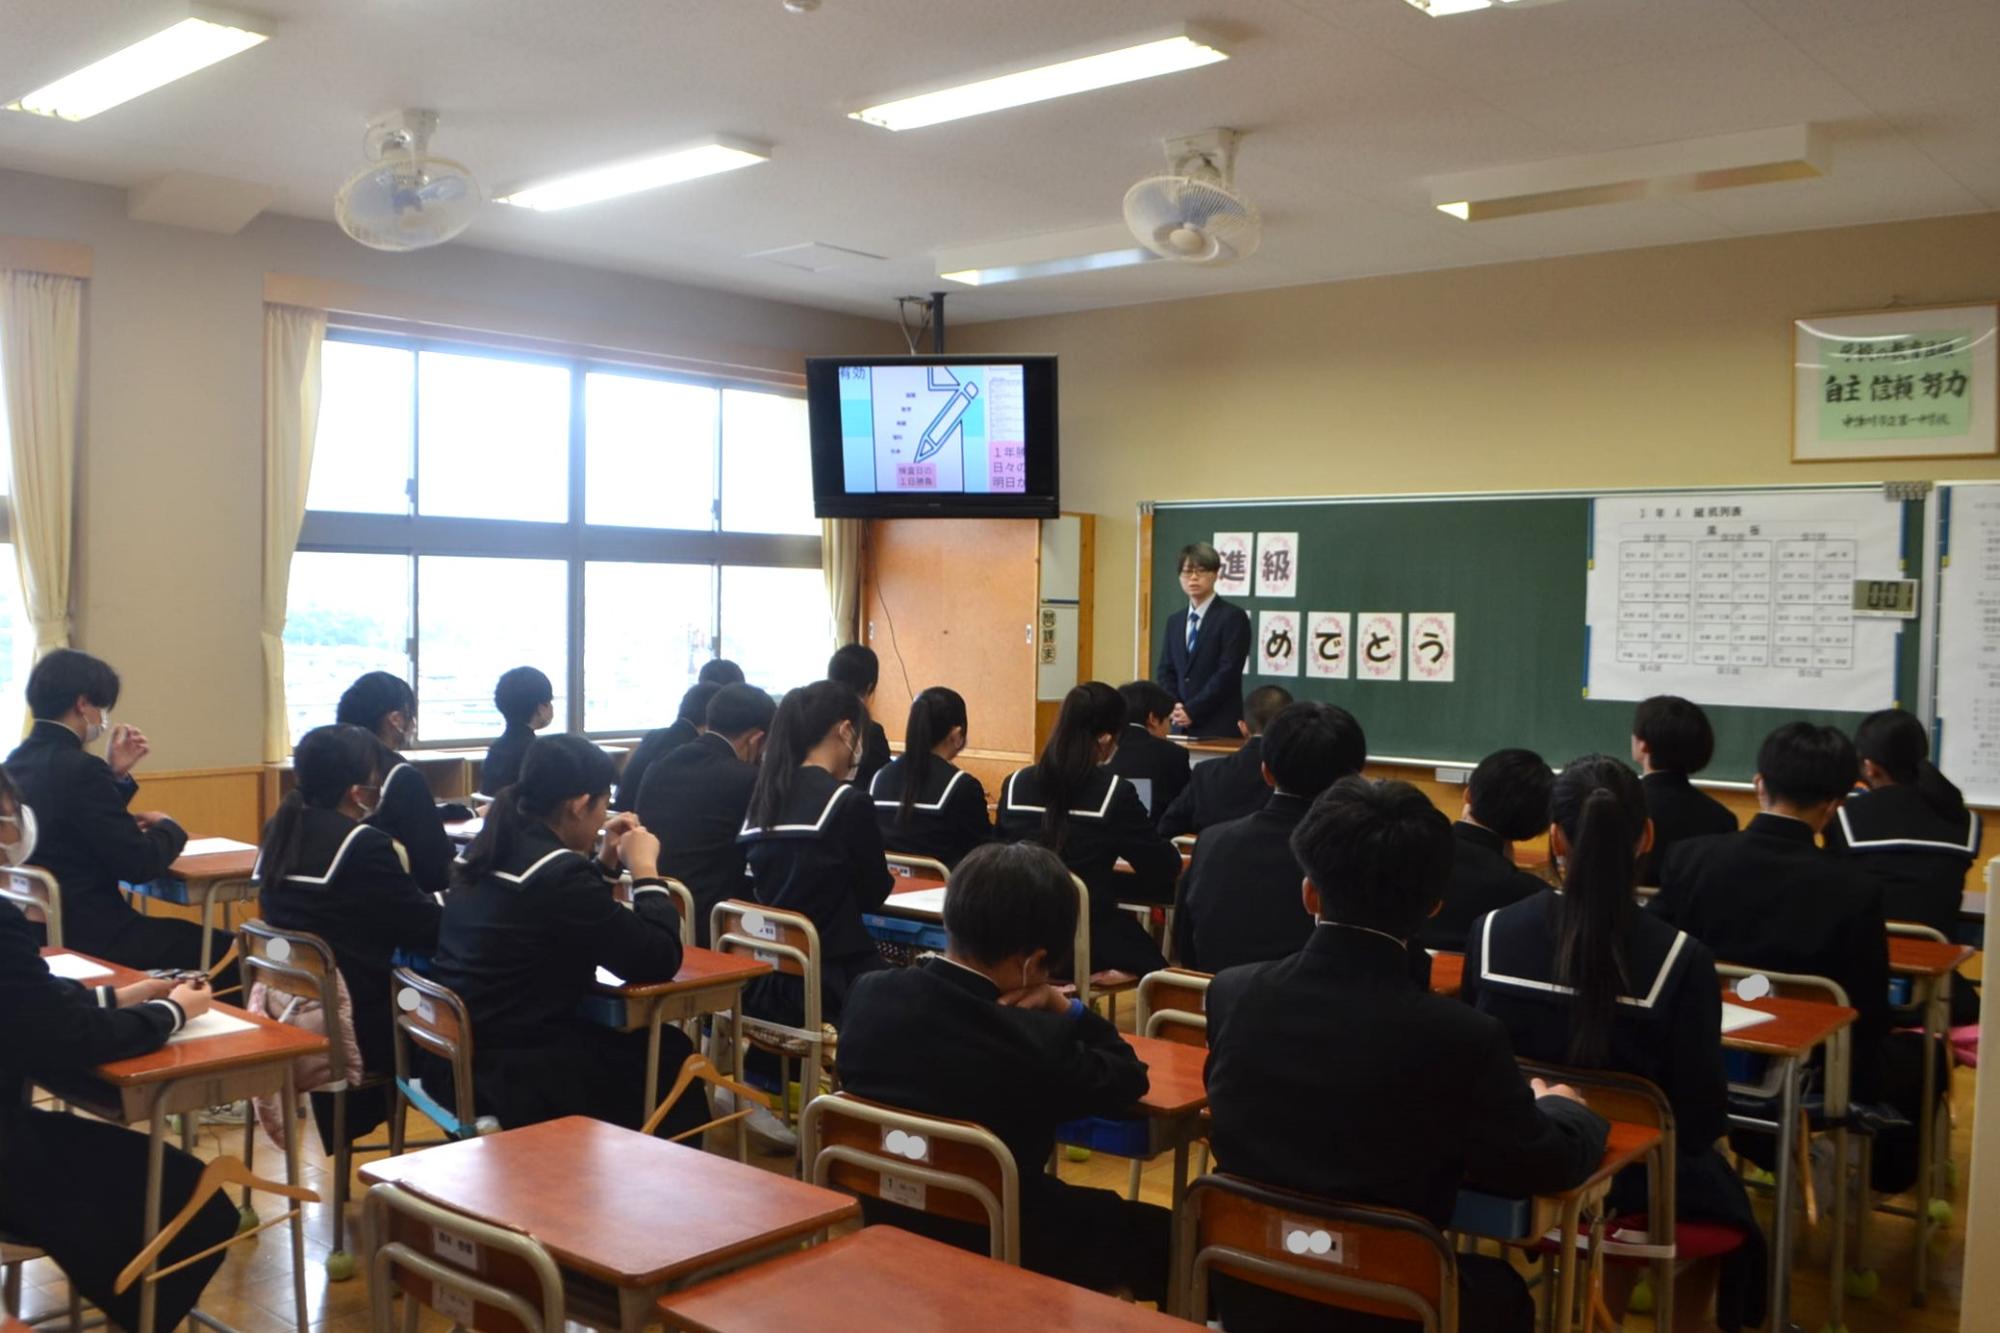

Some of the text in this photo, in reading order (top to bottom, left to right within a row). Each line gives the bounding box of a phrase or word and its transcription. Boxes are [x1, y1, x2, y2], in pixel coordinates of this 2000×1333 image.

[1825, 369, 1968, 403] 自主 信頼 努力
[1219, 550, 1290, 582] 進級
[1266, 630, 1445, 664] めでとう
